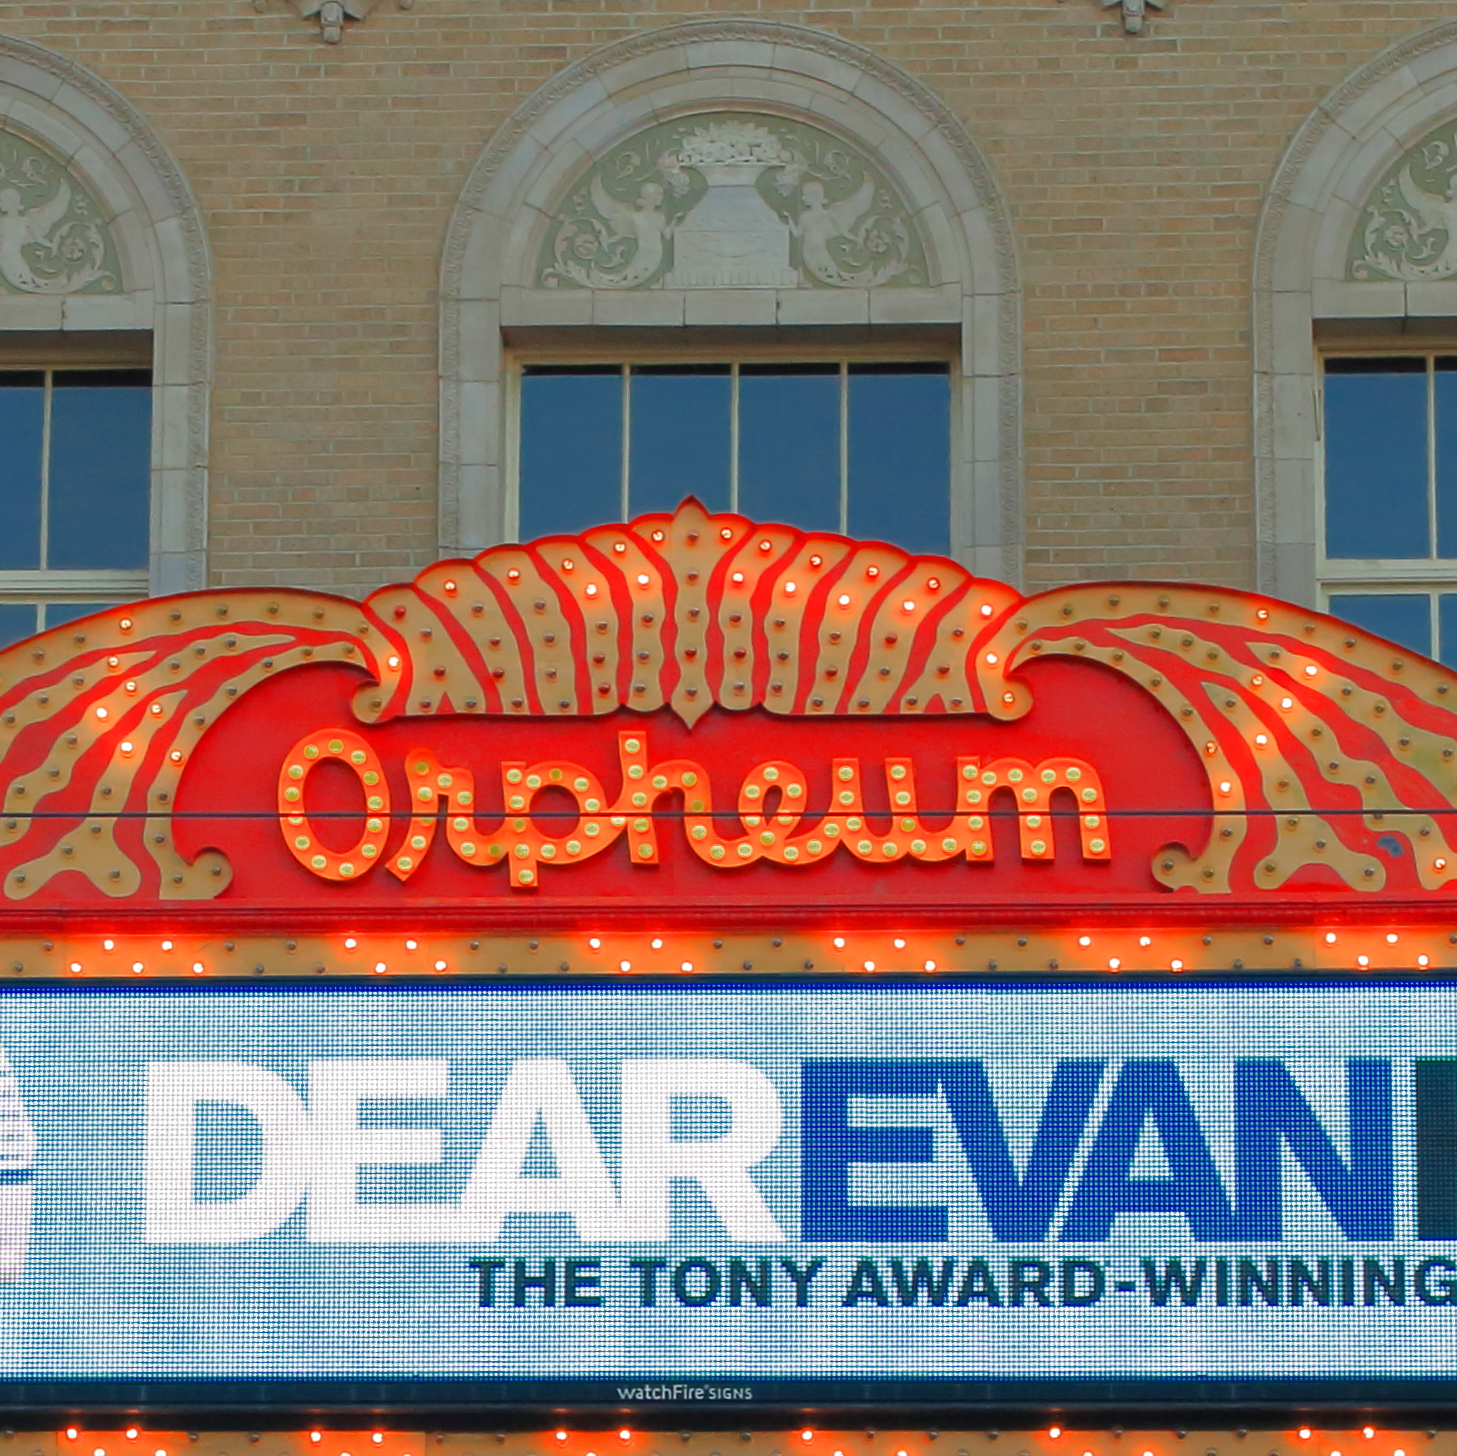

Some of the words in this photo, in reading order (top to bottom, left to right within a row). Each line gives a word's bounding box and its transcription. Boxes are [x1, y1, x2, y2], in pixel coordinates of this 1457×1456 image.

[277, 727, 1112, 889] Orpheum
[142, 1056, 785, 1244] DEAR
[800, 1058, 1392, 1243] EVAN
[469, 1256, 602, 1308] THE
[630, 1256, 822, 1308] TONY
[709, 1388, 753, 1400] SIGNS
